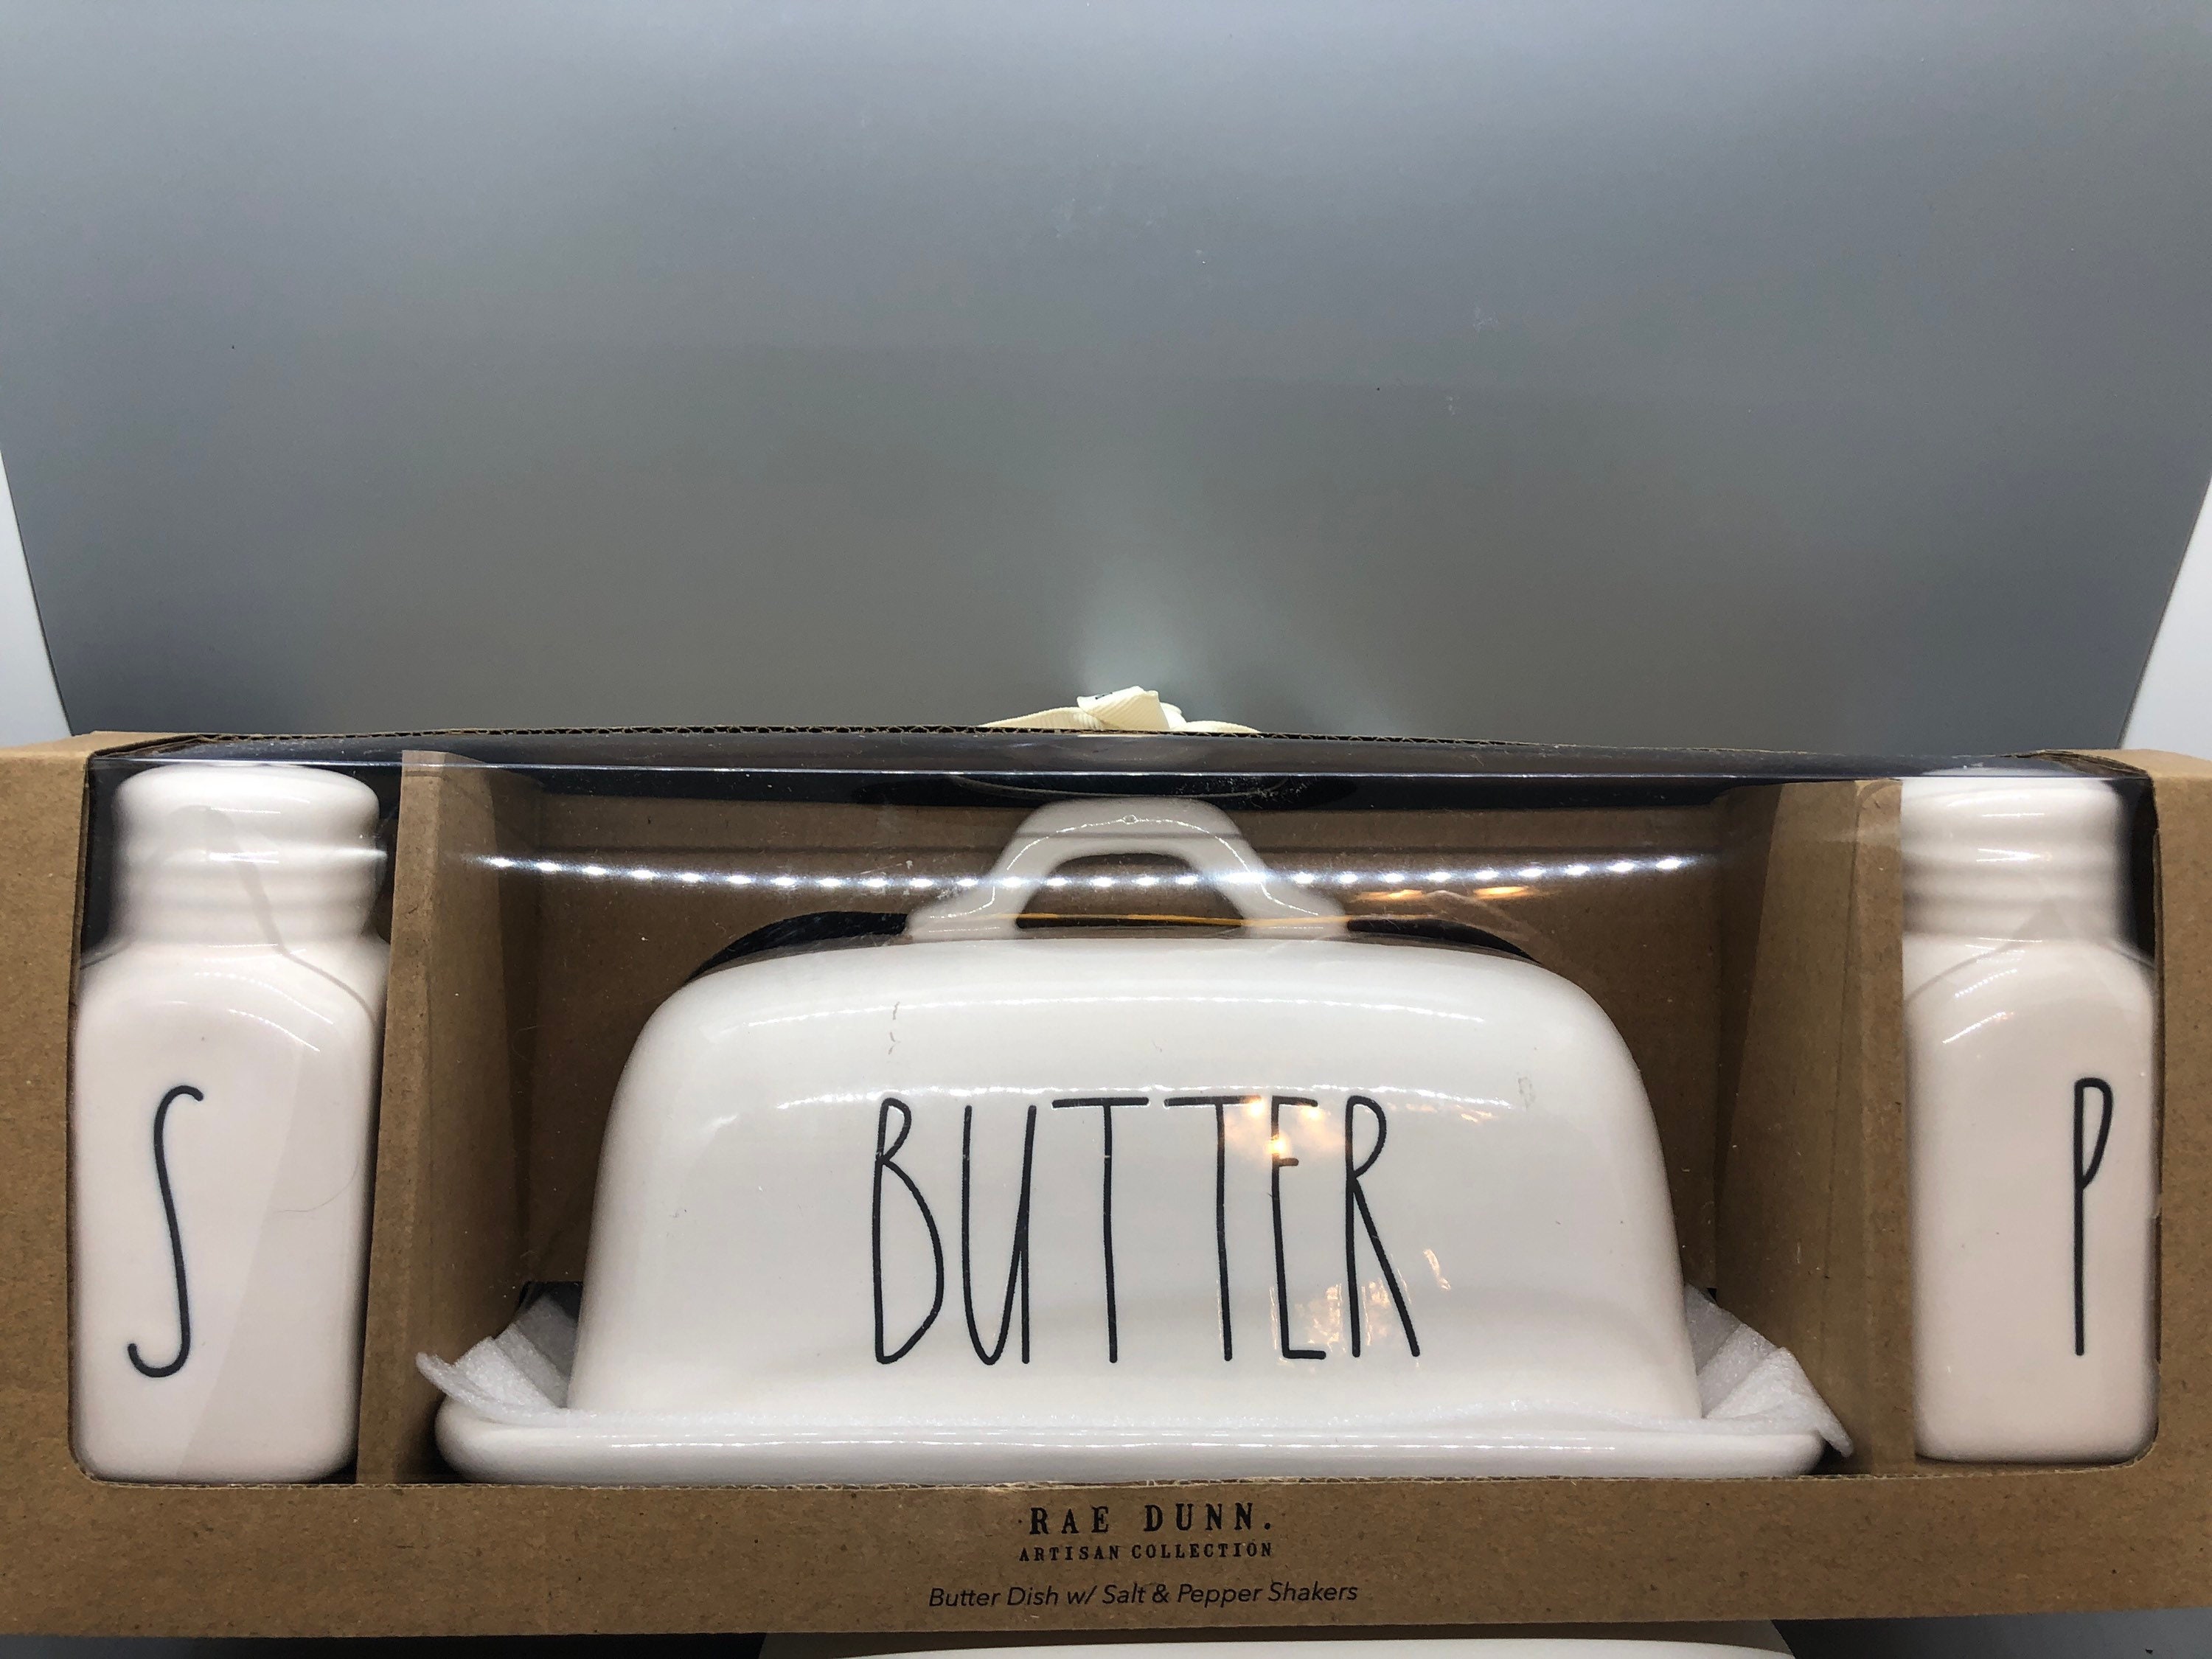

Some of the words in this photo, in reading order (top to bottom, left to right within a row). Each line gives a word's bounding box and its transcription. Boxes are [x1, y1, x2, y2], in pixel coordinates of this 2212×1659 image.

[126, 1084, 204, 1379] S
[871, 1095, 1422, 1366] BUTTER
[2073, 1077, 2115, 1357] P
[928, 1587, 1001, 1607] Butter
[1006, 1585, 1059, 1606] Dish
[1067, 1585, 1097, 1605] w/
[1102, 1582, 1146, 1604] Salt
[1151, 1584, 1169, 1604] &
[1177, 1583, 1262, 1608] Pepper
[1267, 1580, 1358, 1603] Shakers
[1019, 1545, 1121, 1561] ARTISAN
[1131, 1543, 1271, 1559] COLLECTION
[1029, 1506, 1109, 1535] RAE
[1144, 1503, 1271, 1531] DUNN.
